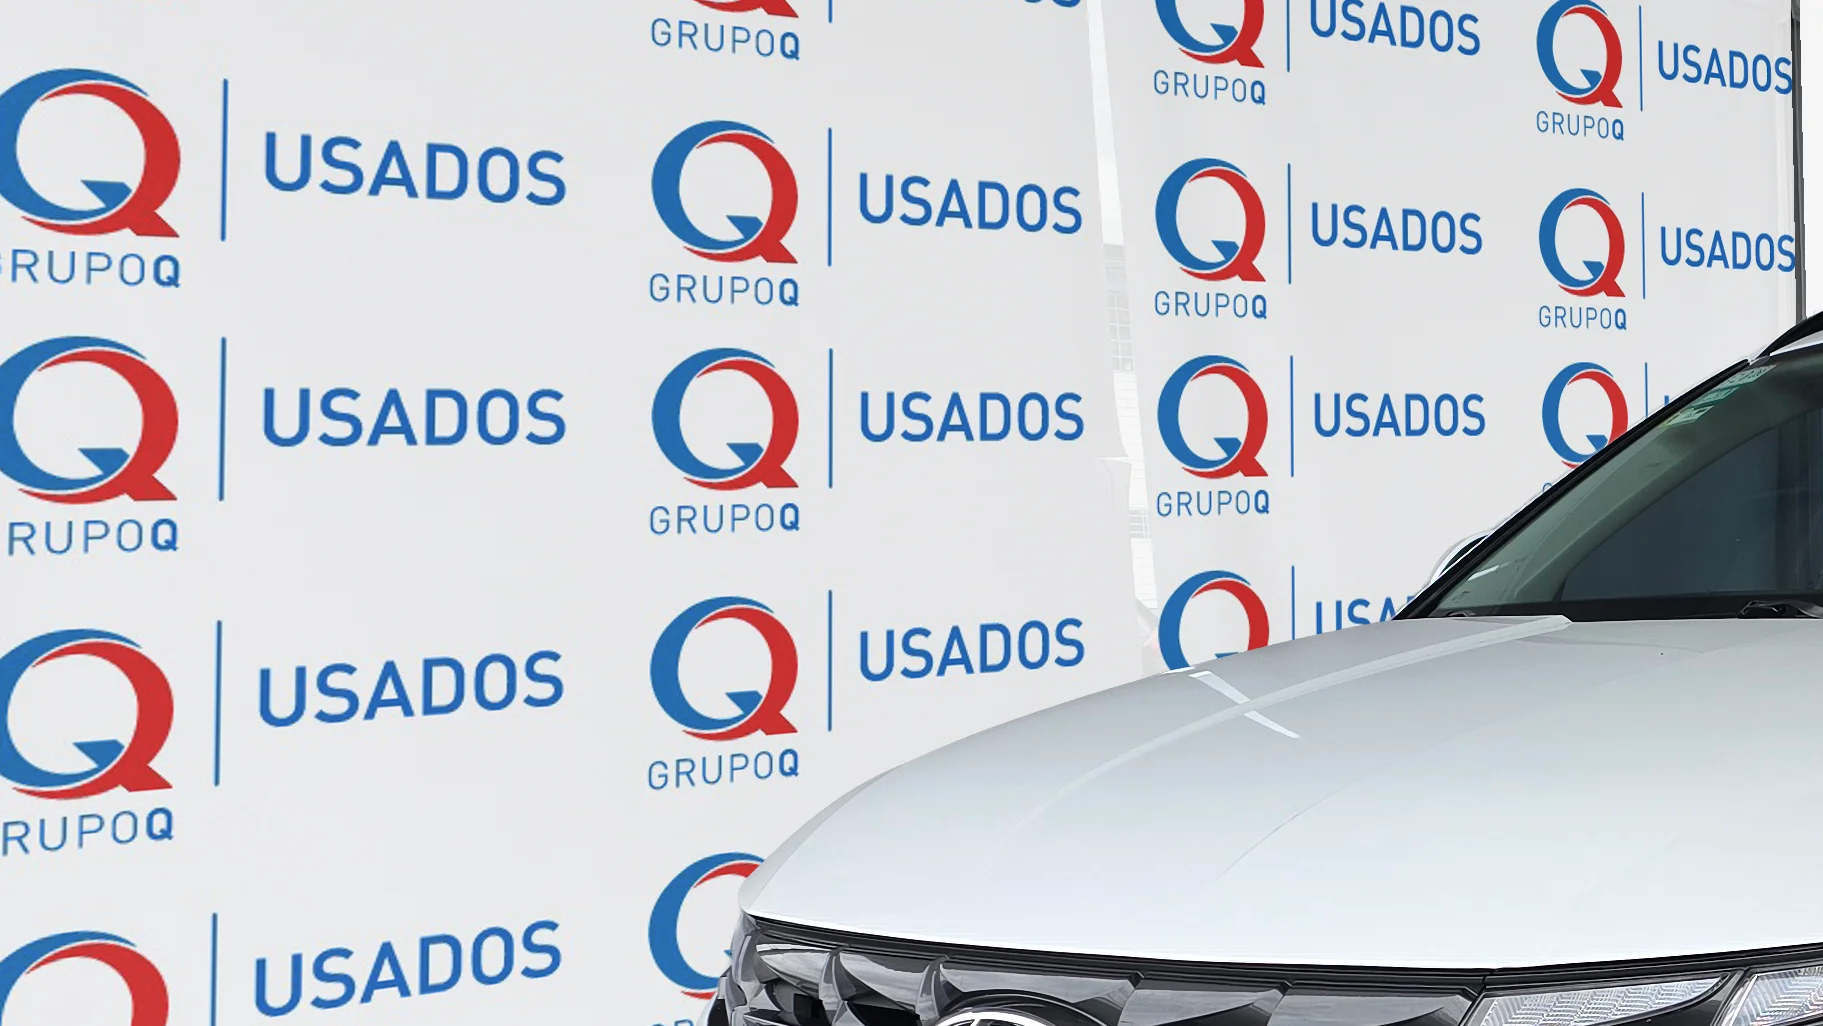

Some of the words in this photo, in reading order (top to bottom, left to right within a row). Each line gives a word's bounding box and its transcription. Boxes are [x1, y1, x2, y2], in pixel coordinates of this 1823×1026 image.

[650, 18, 800, 60] GRUPOQ
[1310, 0, 1480, 56] USADOS
[1154, 70, 1266, 106] GRUPOQ
[1658, 40, 1793, 95] USADOS
[1536, 111, 1624, 141] GRUPOQ
[265, 132, 567, 206] USADOS
[859, 173, 1082, 234] USADOS
[1311, 202, 1482, 255] USADOS
[1660, 226, 1796, 272] USADOS
[649, 273, 799, 306] GRUPOQ
[1155, 290, 1267, 319] GRUPOQ
[1538, 306, 1626, 330] GRUPOQ
[263, 387, 566, 447] USADOS
[860, 391, 1085, 442] USADOS
[1314, 392, 1486, 438] USADOS
[650, 502, 799, 535] GRUPOQ
[1156, 490, 1269, 516] GRUPOQ
[859, 618, 1085, 682] USADOS
[258, 650, 564, 728] USADOS
[648, 749, 799, 789] GRUPOQ
[254, 920, 561, 1017] USADOS
